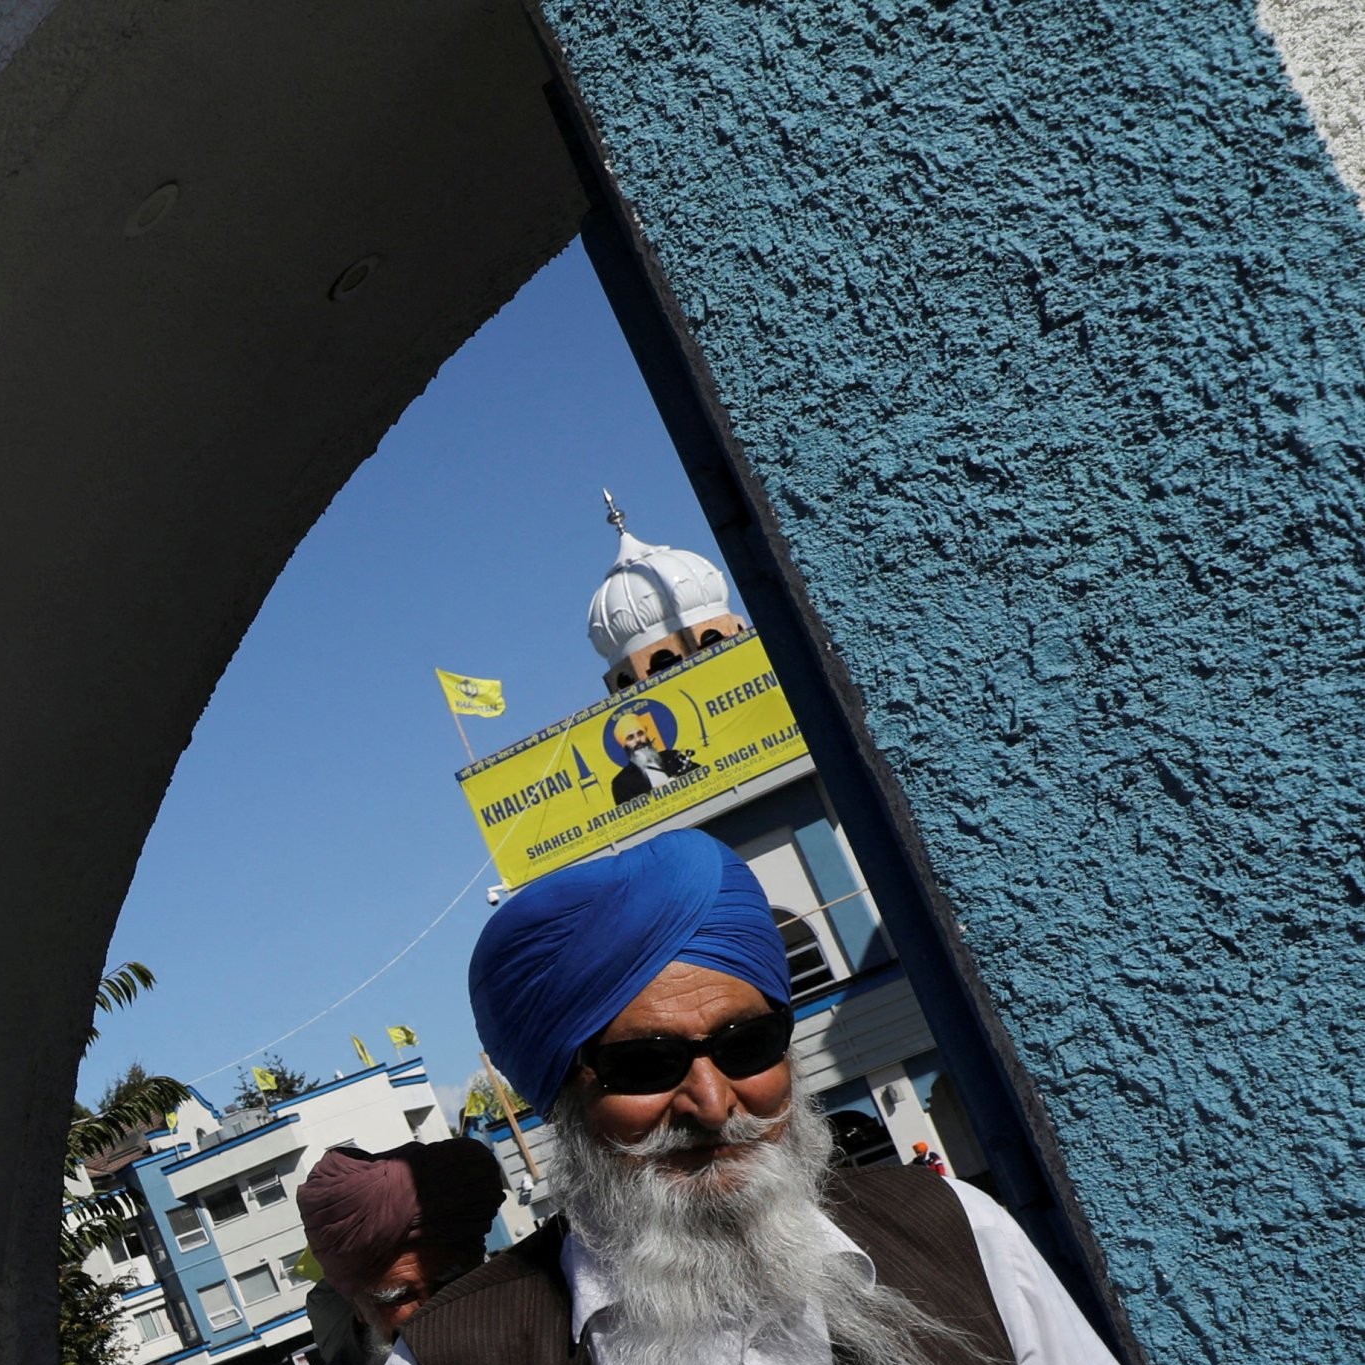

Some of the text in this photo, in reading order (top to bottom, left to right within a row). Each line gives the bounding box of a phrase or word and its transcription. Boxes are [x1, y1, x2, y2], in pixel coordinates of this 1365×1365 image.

[480, 769, 573, 828] KHALISTAN
[705, 671, 780, 718] REFEREN
[526, 723, 802, 860] SHAHEED JATHEDAR HARDEEP SINGH NIJJA
